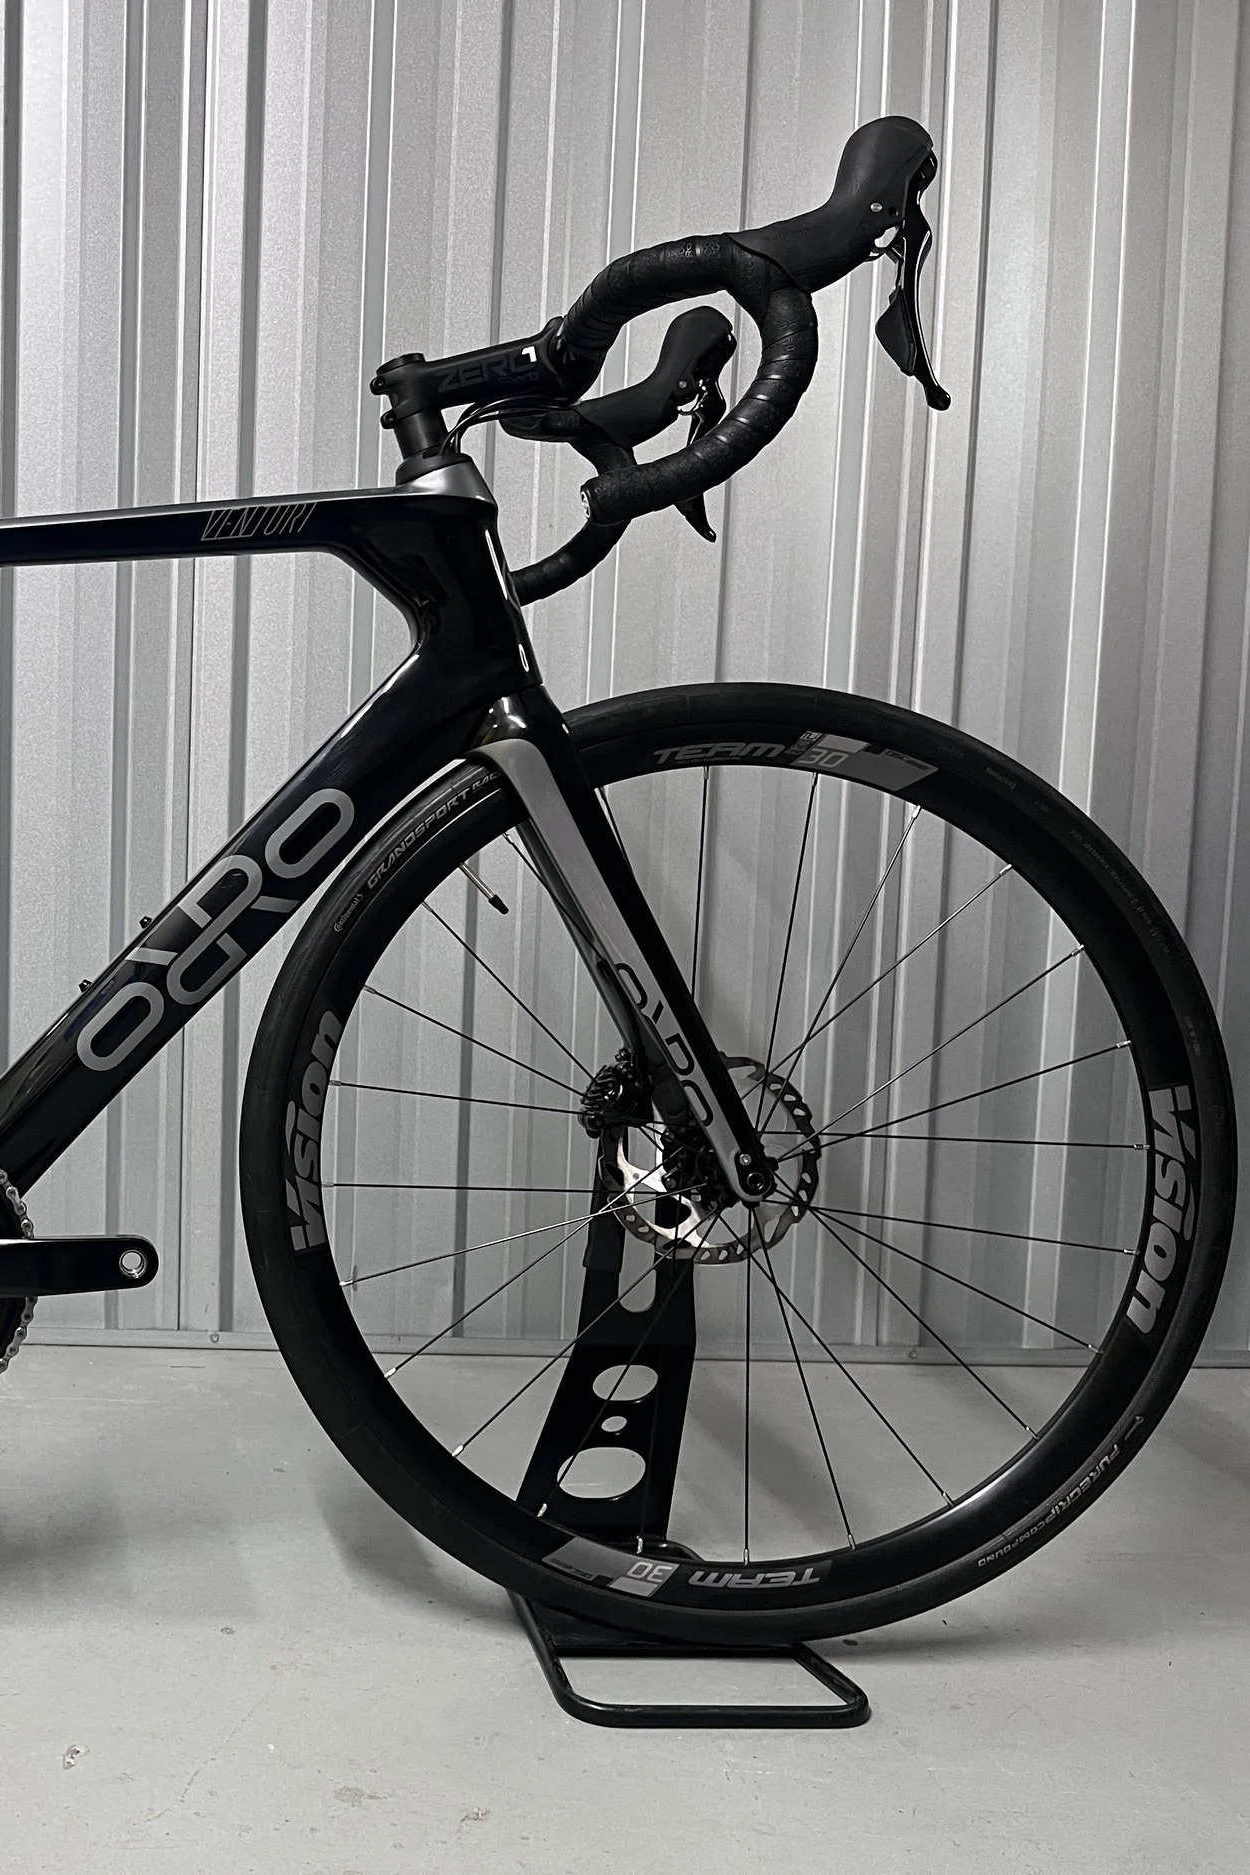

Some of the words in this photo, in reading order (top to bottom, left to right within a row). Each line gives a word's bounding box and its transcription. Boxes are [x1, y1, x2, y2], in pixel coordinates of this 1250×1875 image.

[653, 742, 785, 765] TEAM
[797, 747, 849, 768] 30
[367, 788, 471, 890] GRANDSPORT
[472, 771, 502, 792] RAC
[1045, 1443, 1120, 1523] PUREGRIP
[977, 1521, 1045, 1568] COMPOUND
[626, 1561, 673, 1583] 30
[688, 1567, 821, 1589] TEAM
